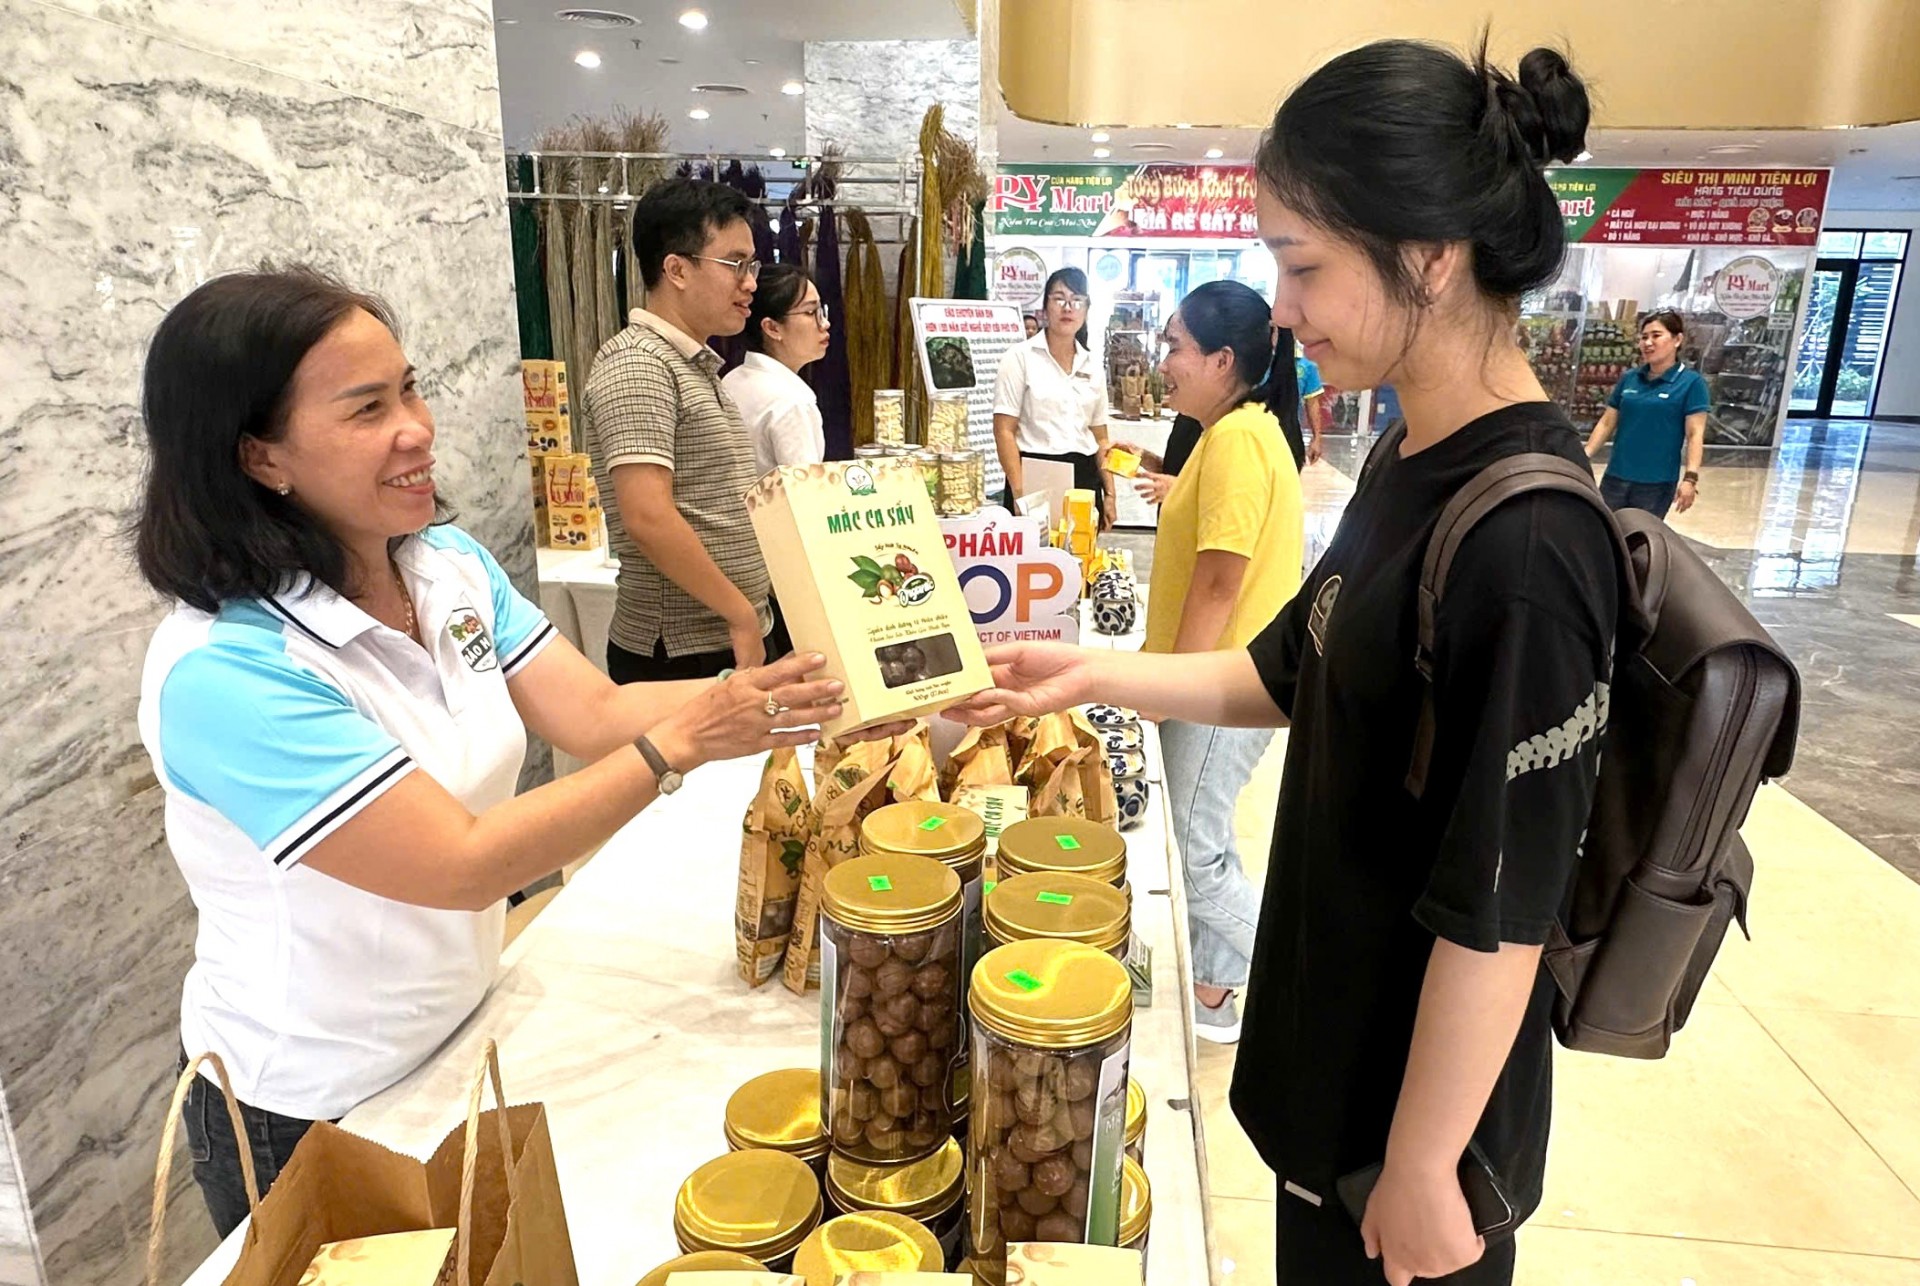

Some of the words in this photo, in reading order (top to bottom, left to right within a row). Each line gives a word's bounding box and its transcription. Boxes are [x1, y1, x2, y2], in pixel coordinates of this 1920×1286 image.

[1661, 171, 1693, 184] SIÊU
[1698, 172, 1719, 186] THỊ
[1722, 173, 1755, 184] MINI
[1795, 173, 1817, 187] LỢI
[1049, 187, 1113, 213] Mart
[1560, 197, 1595, 217] art
[827, 505, 862, 534] MẮC
[865, 508, 885, 529] CA
[887, 500, 915, 527] SẤY
[943, 521, 1023, 557] PHẨM
[957, 562, 1064, 625] OP
[996, 630, 1012, 642] OF
[1013, 628, 1061, 641] VIETNAM
